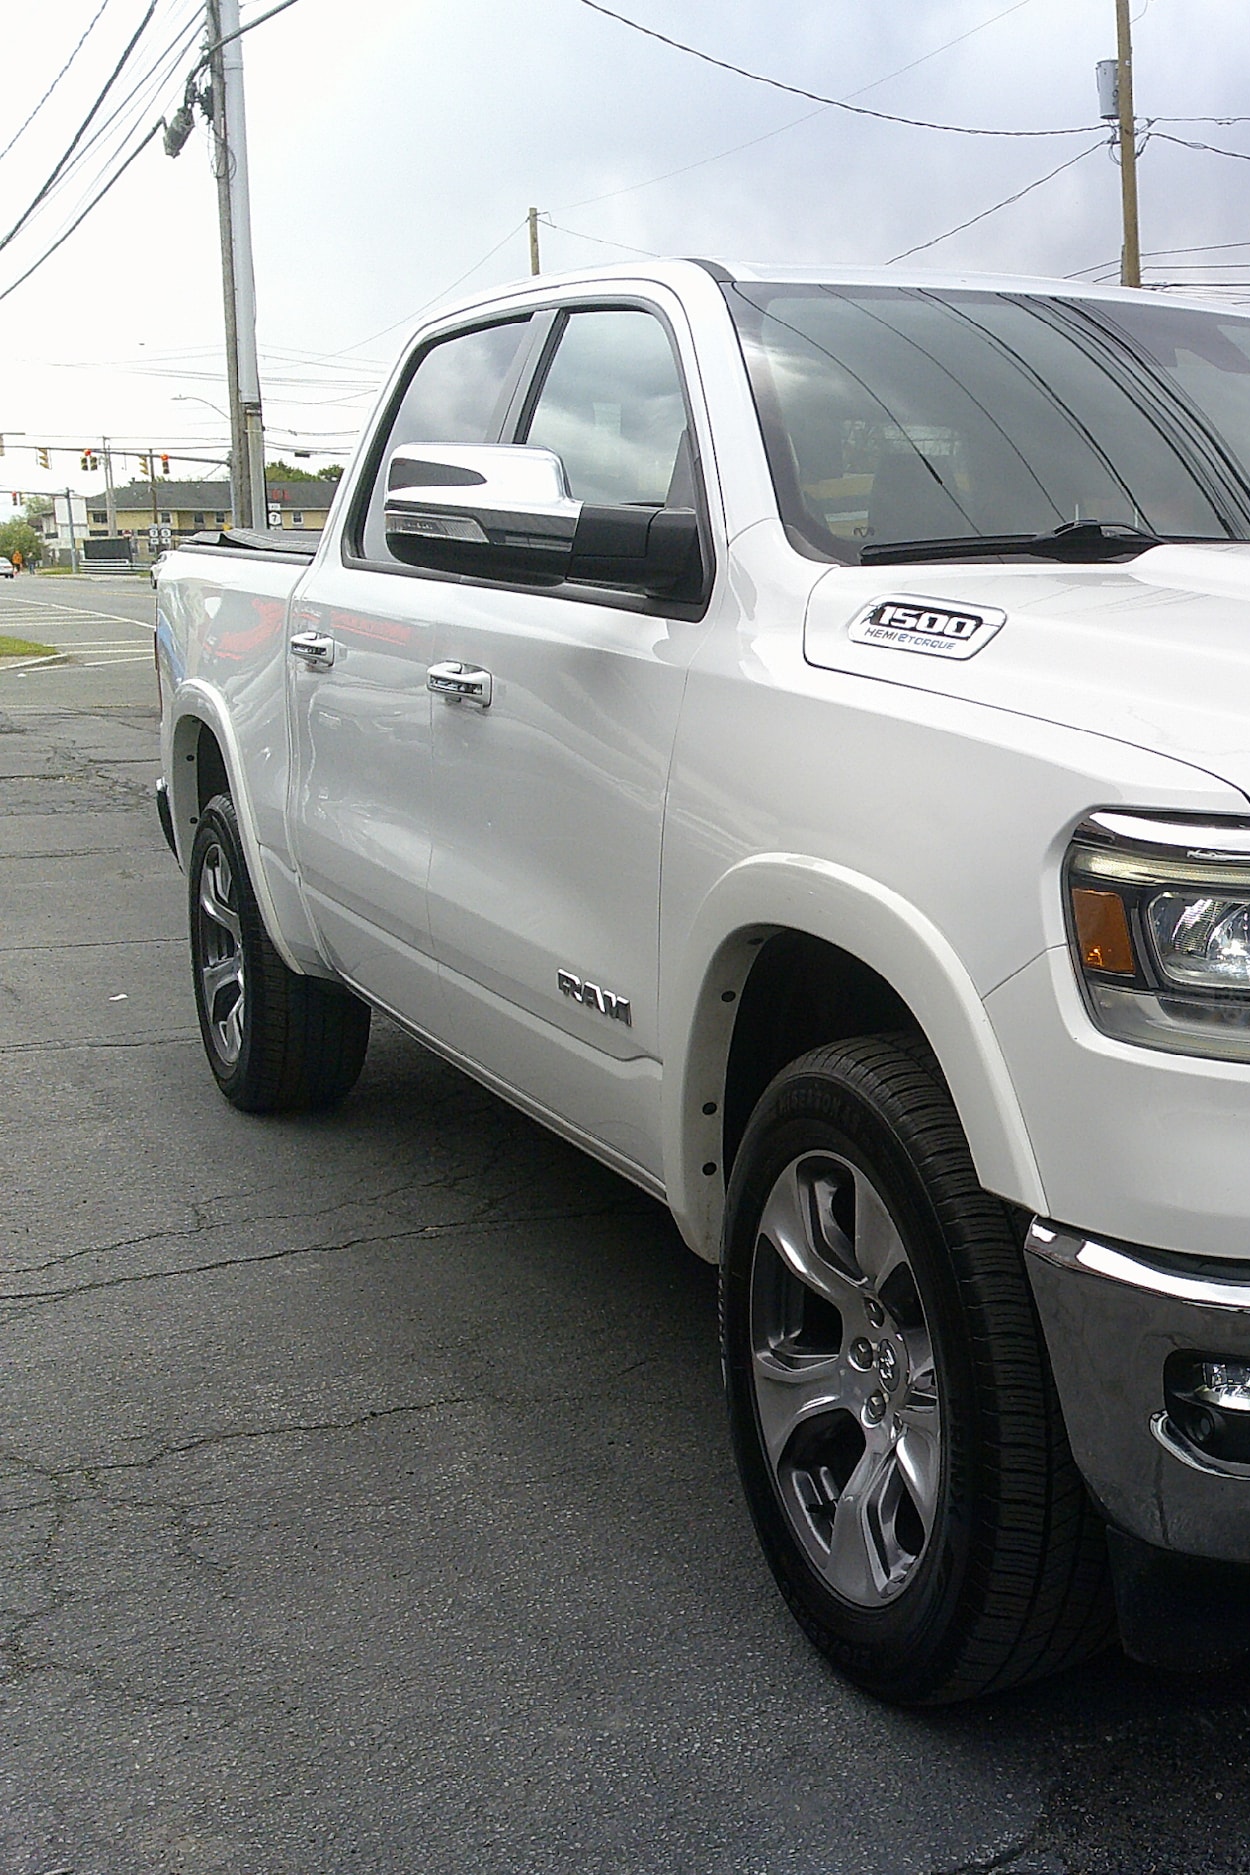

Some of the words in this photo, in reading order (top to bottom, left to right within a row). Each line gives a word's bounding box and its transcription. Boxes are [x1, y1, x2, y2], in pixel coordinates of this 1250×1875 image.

[864, 627, 899, 641] HEMI
[879, 605, 977, 638] 1500
[556, 968, 633, 1027] RAM
